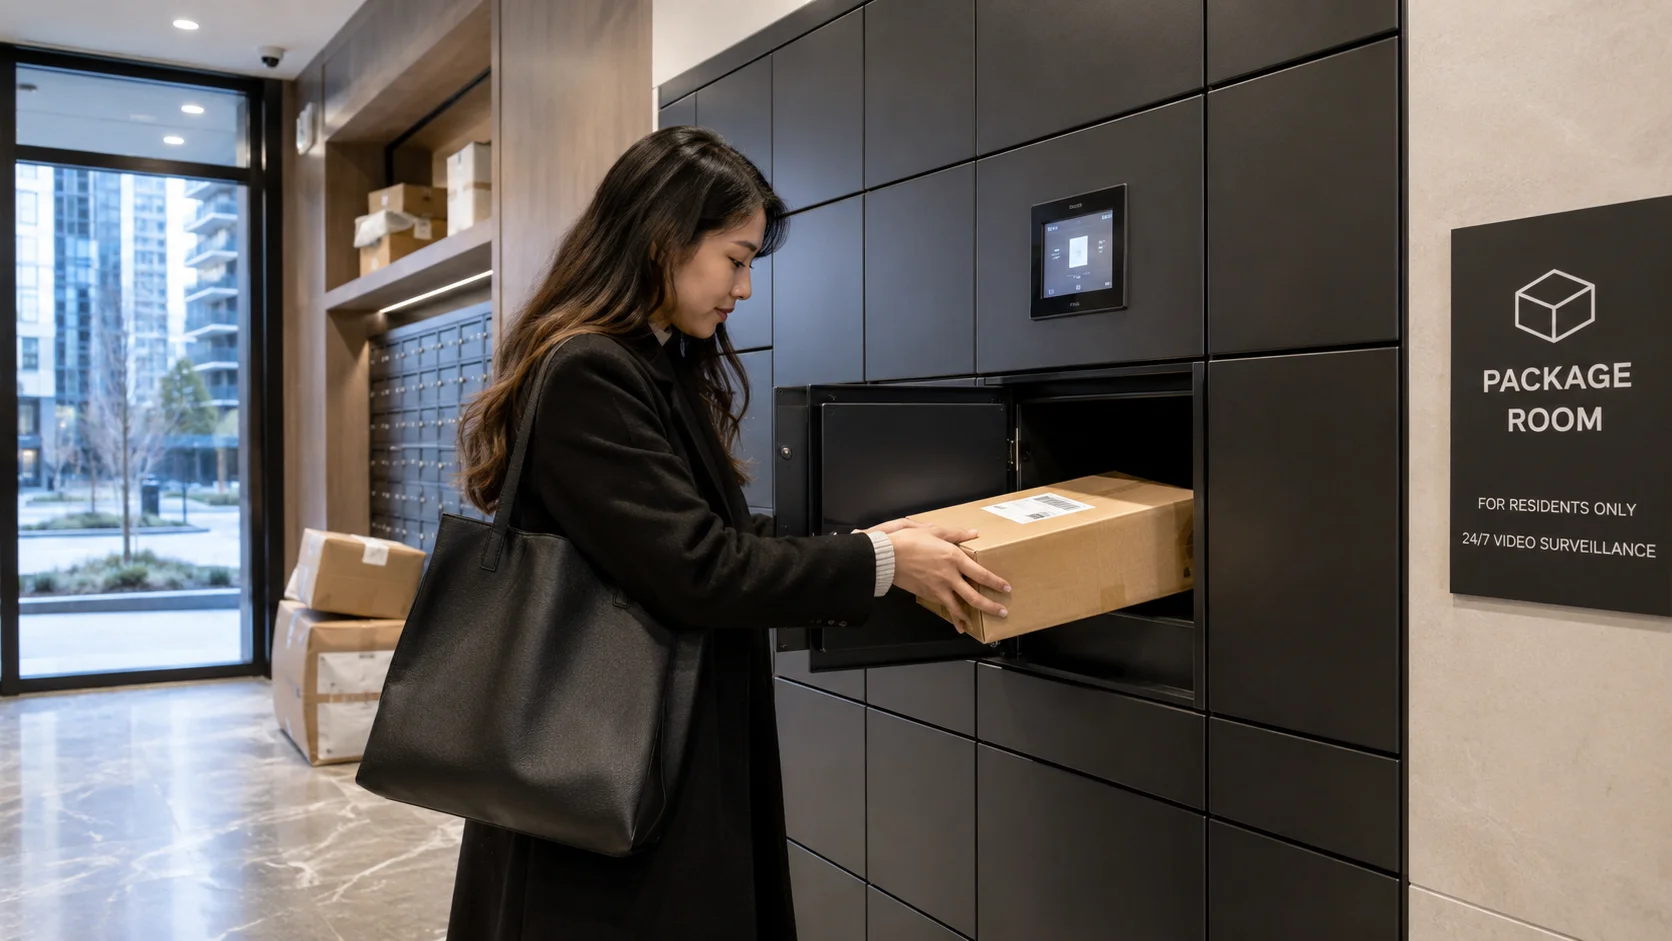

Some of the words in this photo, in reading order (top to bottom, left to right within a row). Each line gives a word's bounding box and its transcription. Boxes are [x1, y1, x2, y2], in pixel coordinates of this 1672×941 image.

[1483, 361, 1632, 393] PACKAGE
[1508, 406, 1602, 433] ROOM
[1478, 497, 1506, 511] FOR
[1509, 498, 1590, 515] RESIDENTS
[1593, 501, 1637, 517] ONLY
[1462, 531, 1490, 547] 24/7
[1493, 533, 1536, 550] VIDEO
[1539, 536, 1657, 559] SURVEILLANCE
